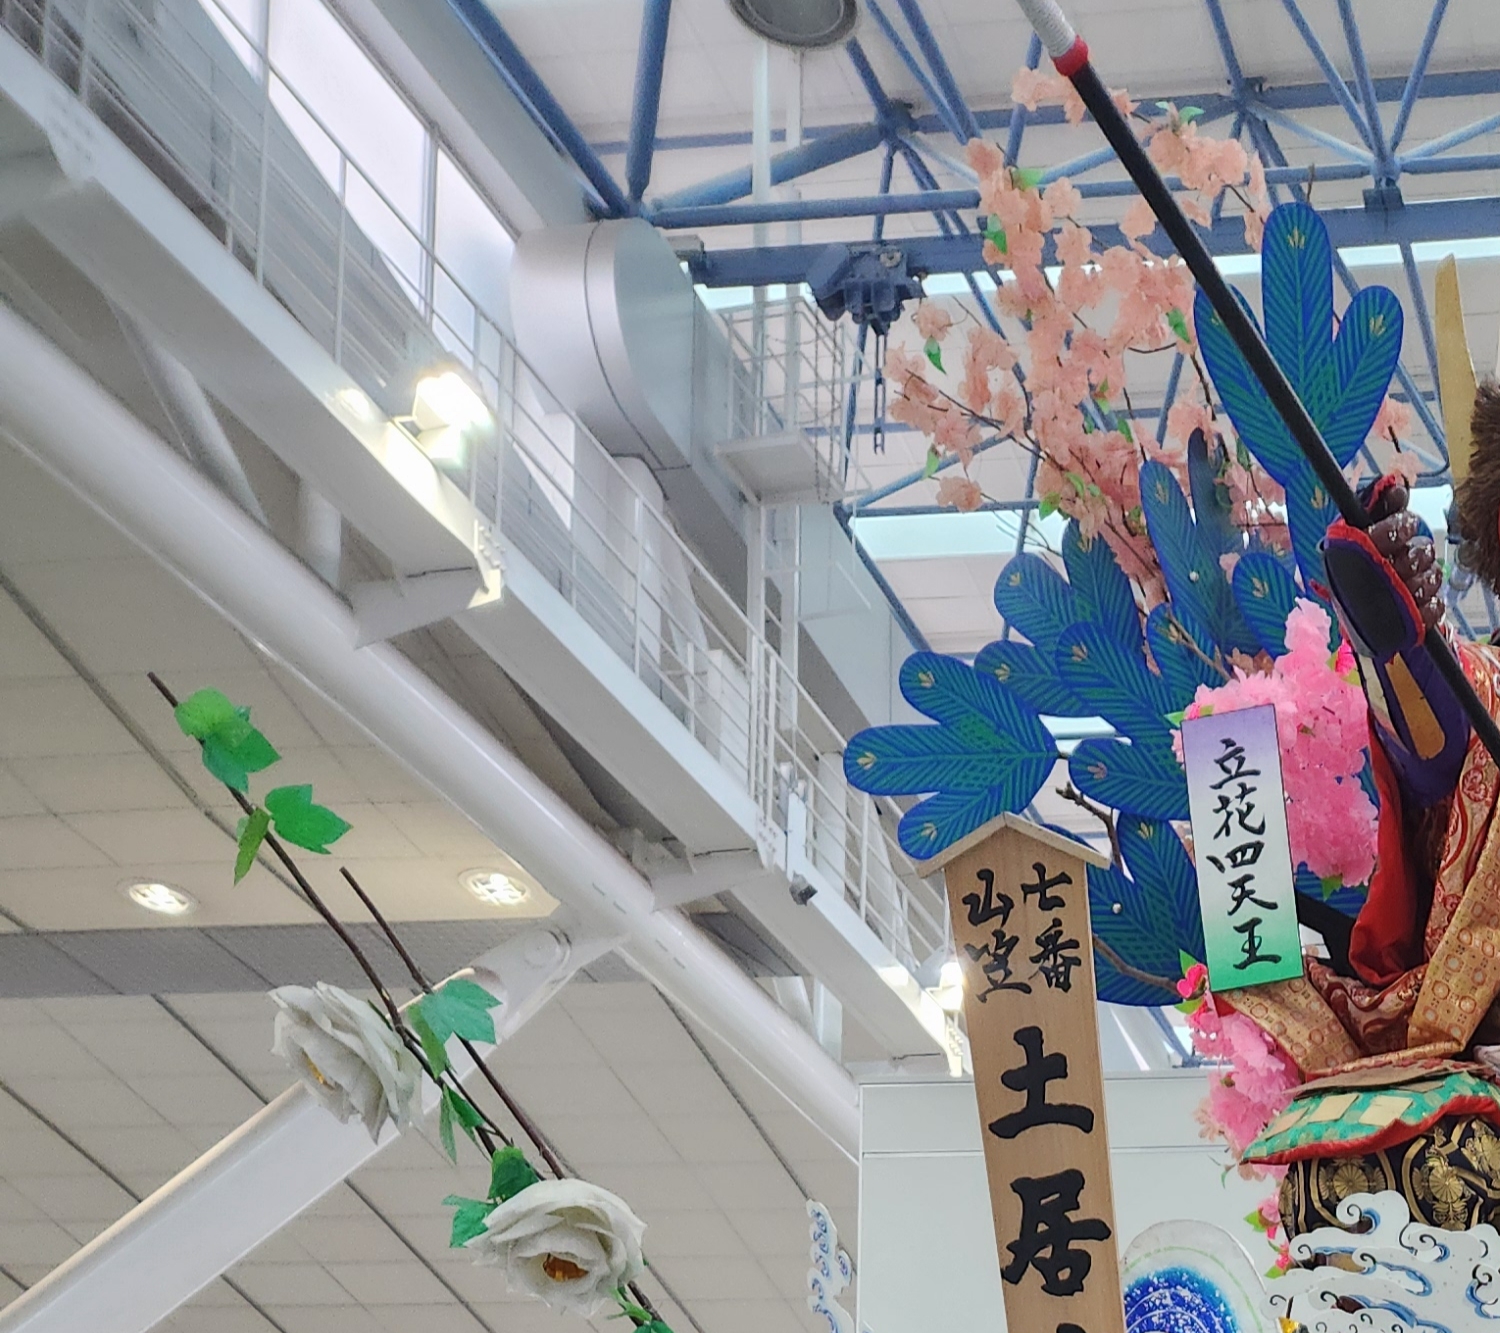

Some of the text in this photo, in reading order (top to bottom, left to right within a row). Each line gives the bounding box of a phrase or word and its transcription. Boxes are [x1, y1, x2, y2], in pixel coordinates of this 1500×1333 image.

[1206, 738, 1283, 971] 立花四天王
[962, 868, 1031, 1002] 山笠
[1021, 862, 1083, 993] 七番
